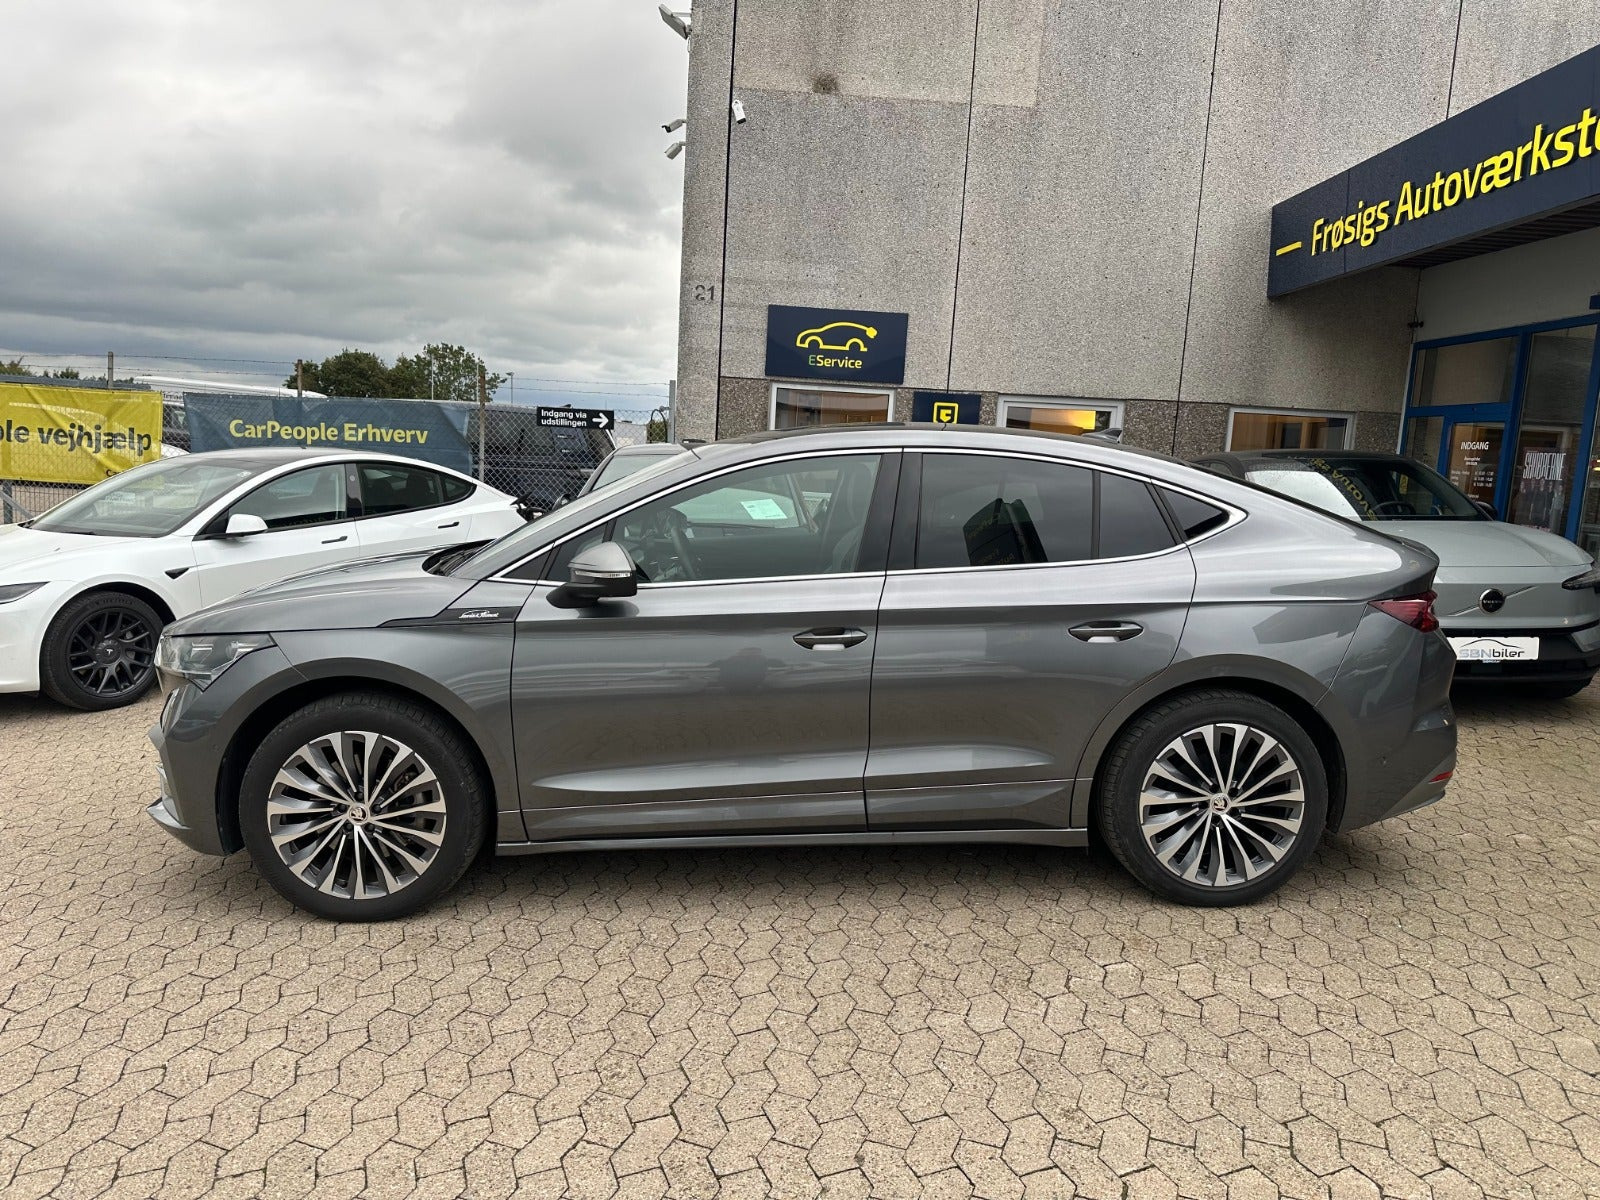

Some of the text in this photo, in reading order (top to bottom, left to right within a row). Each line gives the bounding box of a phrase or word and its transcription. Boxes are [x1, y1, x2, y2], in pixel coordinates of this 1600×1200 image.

[1311, 200, 1390, 256] Frøsigs
[808, 354, 863, 369] EService
[541, 409, 574, 419] Indgang
[541, 418, 587, 427] udstillingen
[229, 419, 428, 444] CarPeople Erhverv
[37, 422, 152, 457] vejhjælp
[1460, 441, 1490, 450] INDGANG
[1459, 648, 1525, 660] SBNbiler
